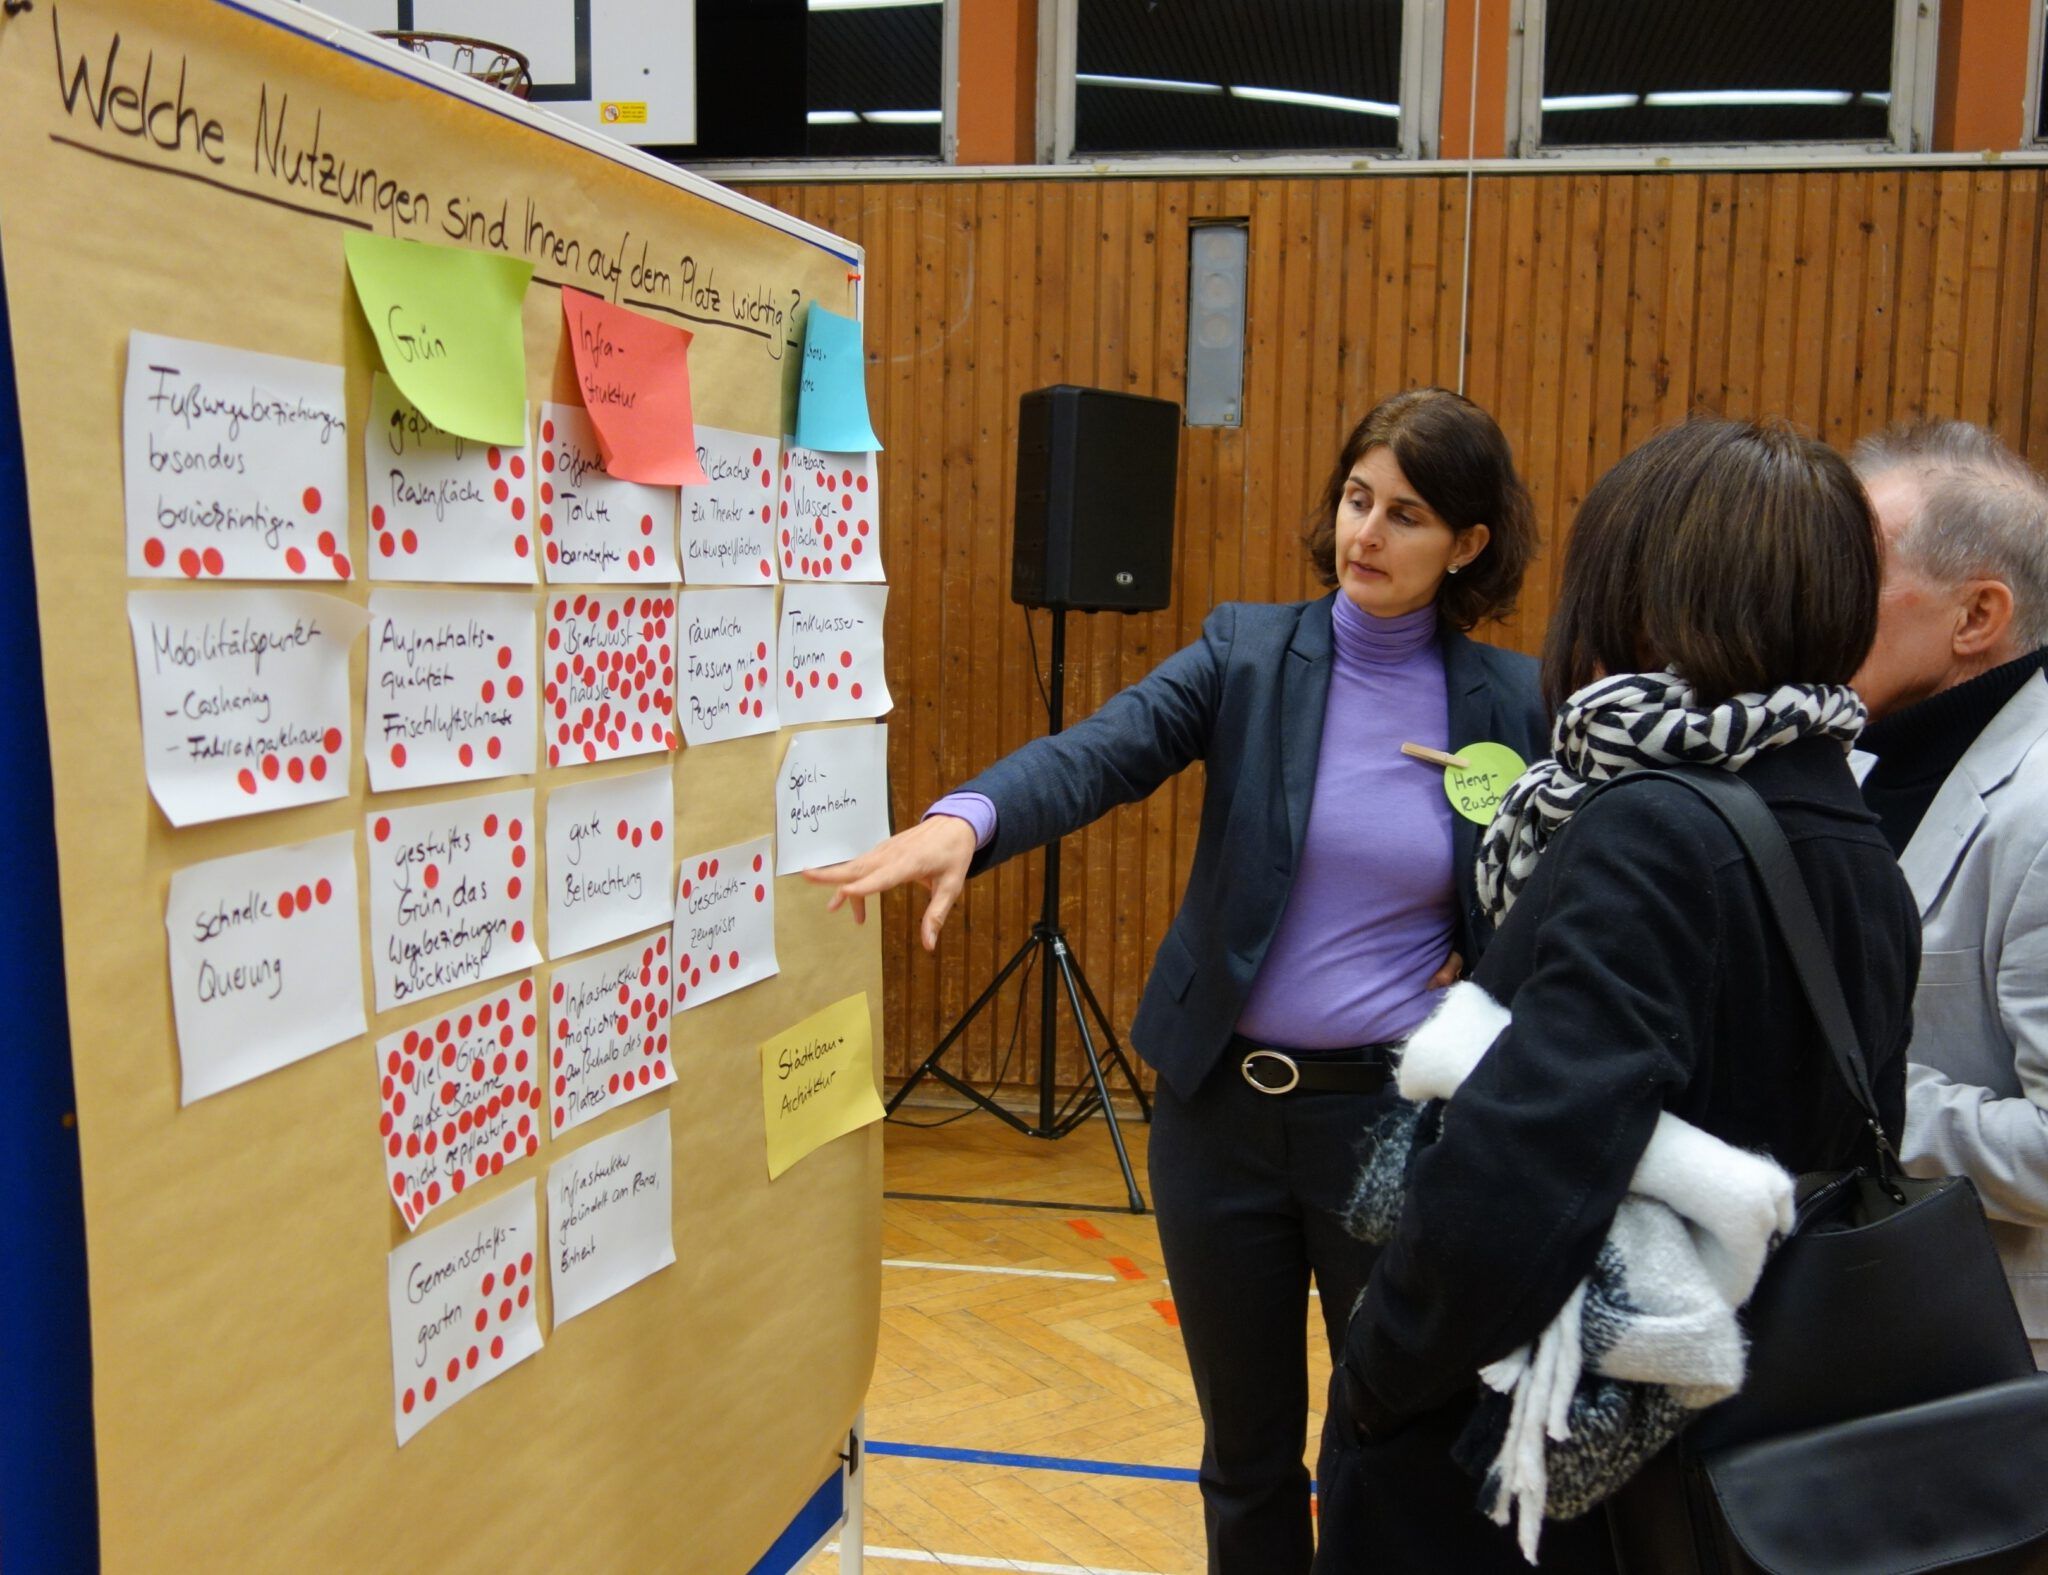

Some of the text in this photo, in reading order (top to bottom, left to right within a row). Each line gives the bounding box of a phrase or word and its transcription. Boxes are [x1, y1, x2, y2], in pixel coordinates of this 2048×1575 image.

[52, 3, 225, 165] Welche
[254, 81, 430, 240] Nutzungen
[441, 198, 509, 251] sind
[523, 196, 580, 273] Ihnen
[588, 230, 631, 305] auf
[630, 240, 672, 294] dem
[681, 254, 722, 314] Platz
[387, 305, 448, 363] Grün
[579, 311, 625, 368] Infra-
[389, 468, 485, 523] Rasenfläche
[560, 492, 612, 528] Toilette
[709, 497, 744, 523] Theater
[151, 616, 322, 676] Mobilitätspunkt
[688, 651, 755, 692] Fassung mit
[566, 810, 602, 865] gute
[452, 874, 487, 907] das
[563, 864, 642, 907] Beleuchtung
[198, 958, 283, 1002] Querung
[456, 1037, 497, 1073] Grün
[622, 1033, 642, 1057] des
[447, 1076, 505, 1117] Bäume
[568, 1085, 606, 1120] Platzes
[406, 1157, 437, 1197] nicht
[415, 1302, 462, 1368] garten
